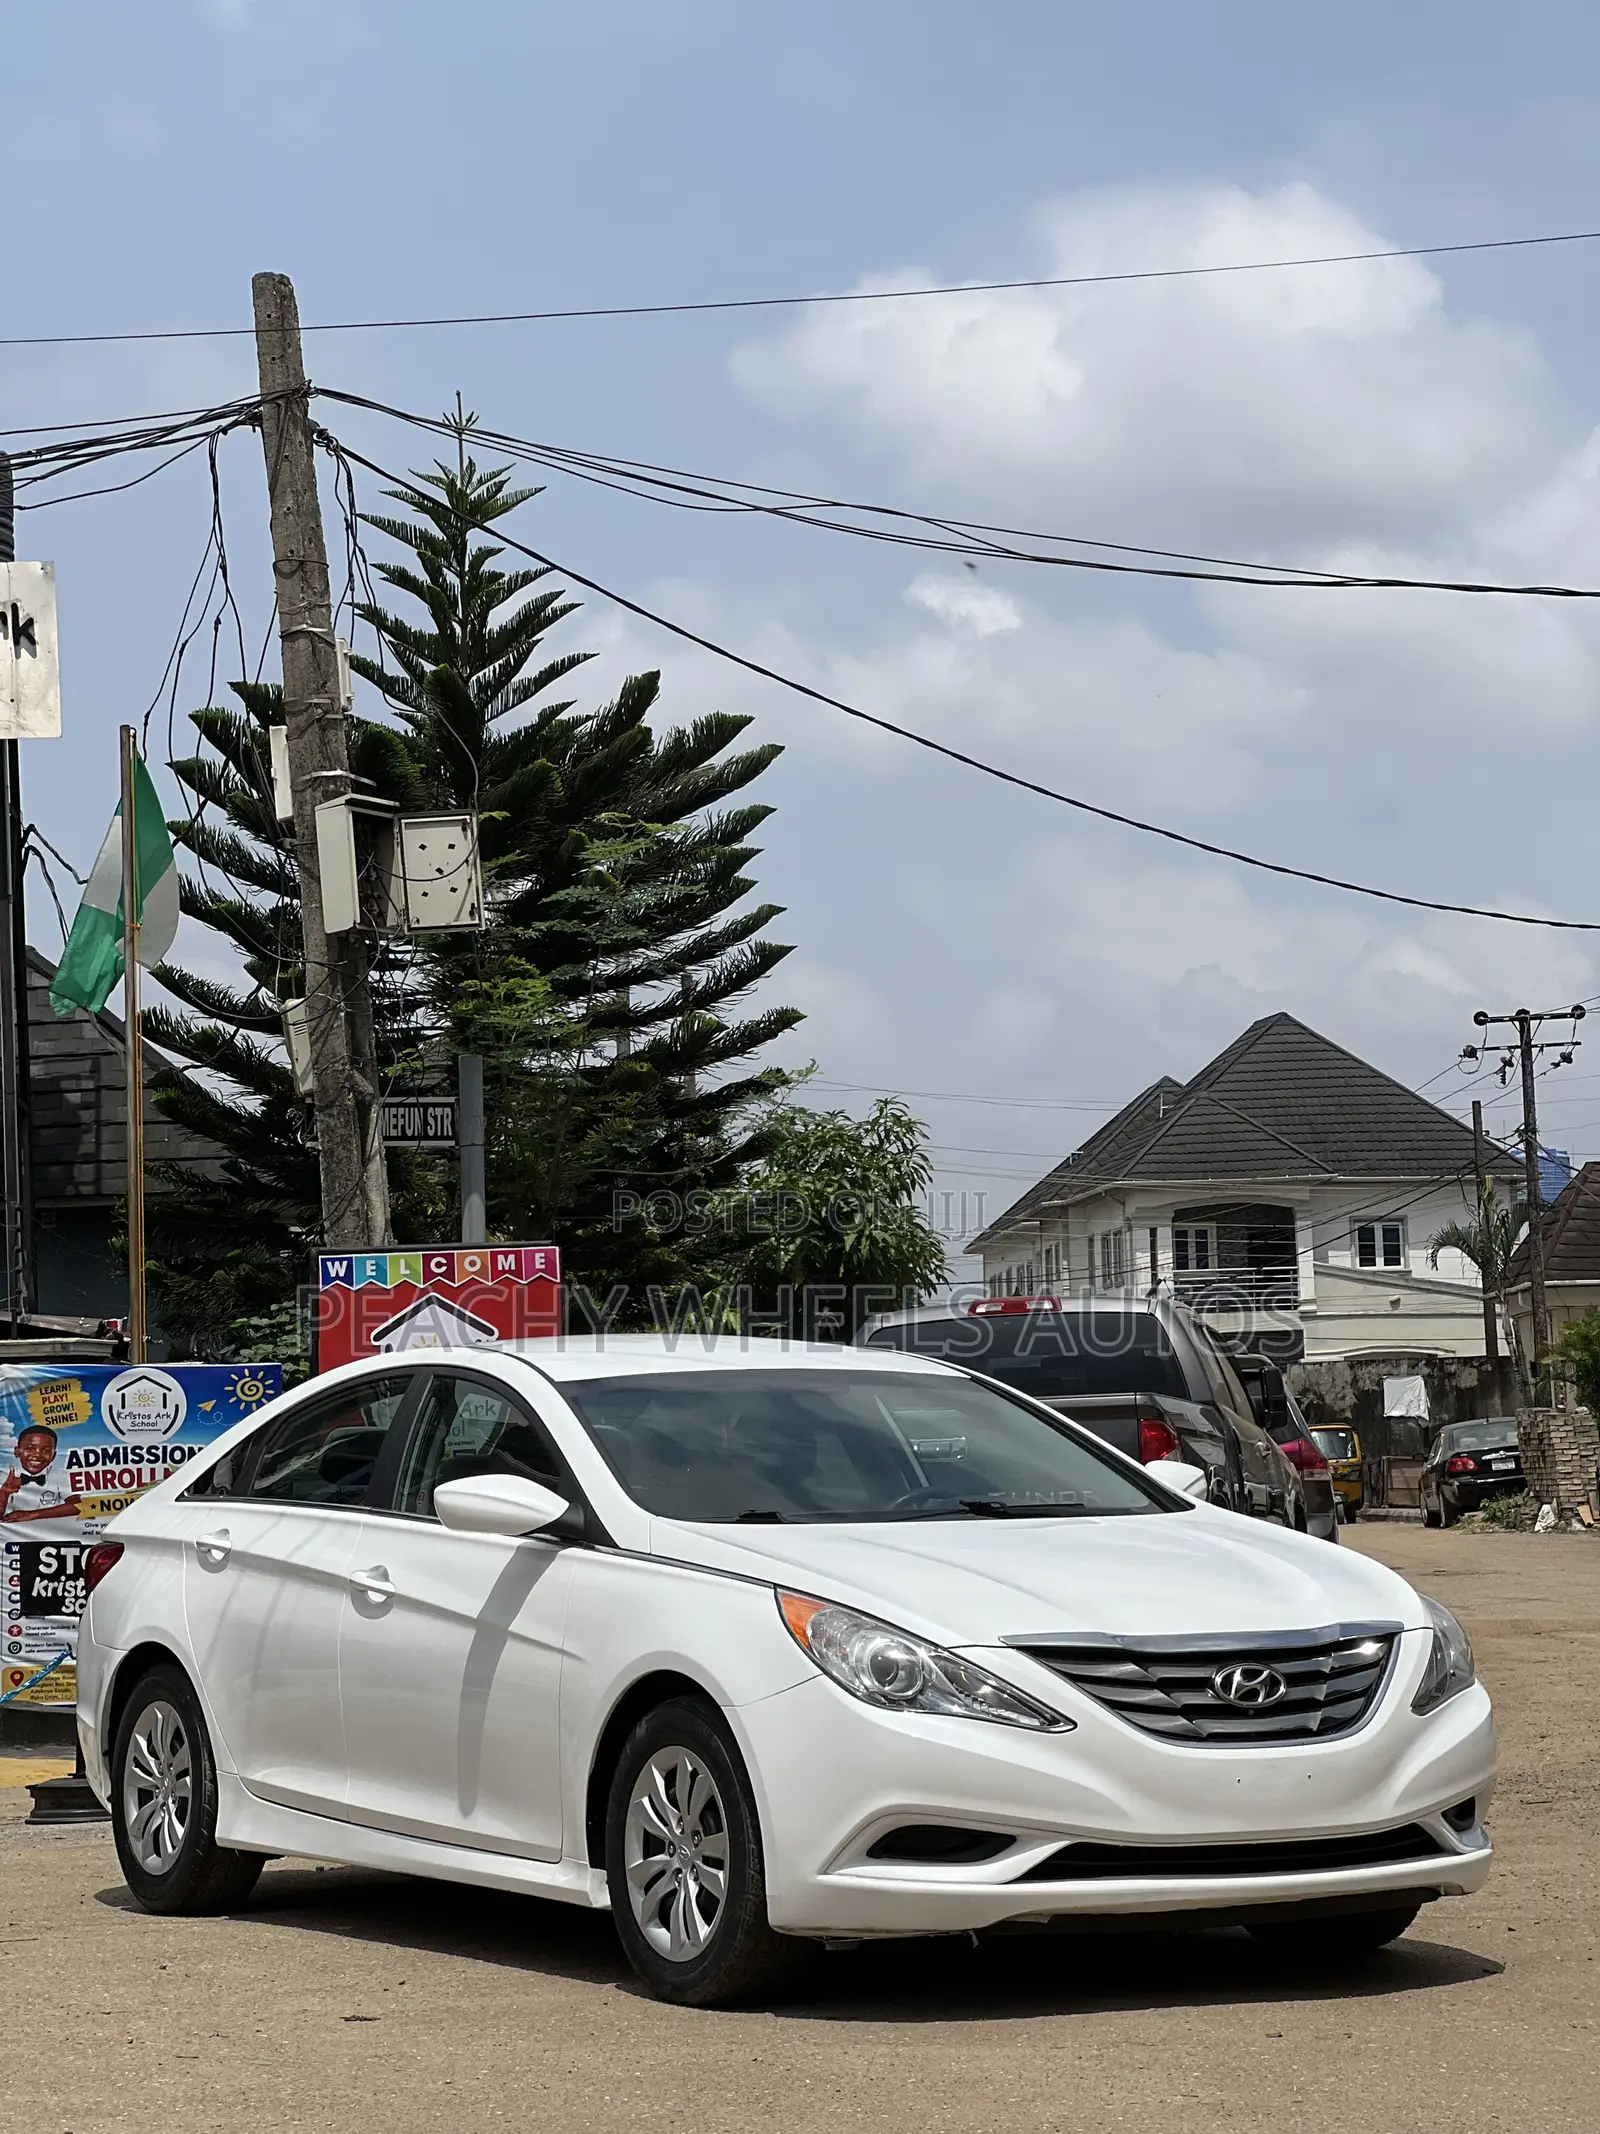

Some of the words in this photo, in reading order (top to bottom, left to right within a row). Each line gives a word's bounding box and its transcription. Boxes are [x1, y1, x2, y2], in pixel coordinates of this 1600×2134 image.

[0, 602, 37, 659] k
[427, 1107, 452, 1136] STR
[326, 1252, 546, 1278] WELCOME
[40, 1383, 71, 1395] LEARN!
[42, 1393, 68, 1404] PLAY!
[43, 1402, 74, 1415] GROW!
[155, 1412, 172, 1420] Ark
[462, 1400, 496, 1418] Ark
[45, 1412, 78, 1425] SHINE!
[131, 1420, 158, 1428] School
[70, 1468, 174, 1492] ENROLL
[38, 1546, 91, 1574] ST
